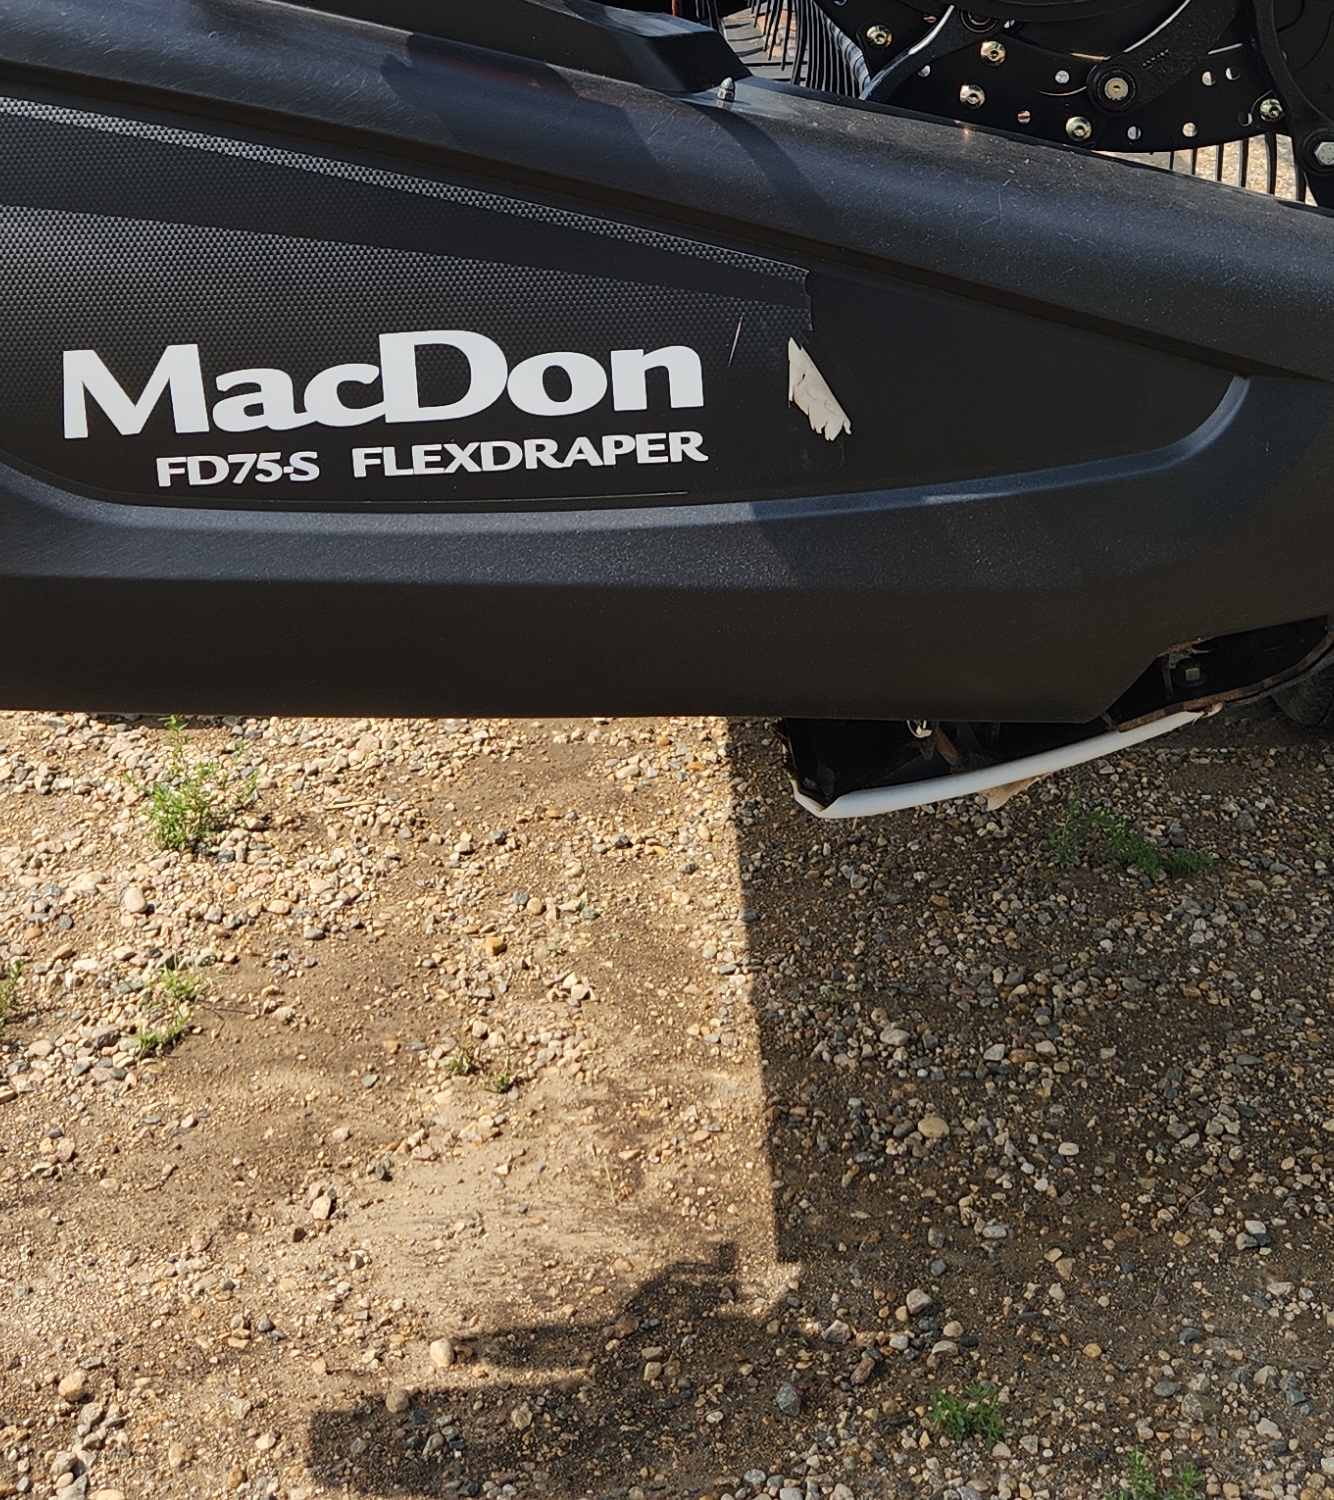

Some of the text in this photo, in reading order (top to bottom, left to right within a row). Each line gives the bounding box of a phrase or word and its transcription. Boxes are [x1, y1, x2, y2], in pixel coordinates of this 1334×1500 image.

[63, 330, 704, 439] MacDon
[157, 431, 709, 487] FD75-S FLEXDRAPER
